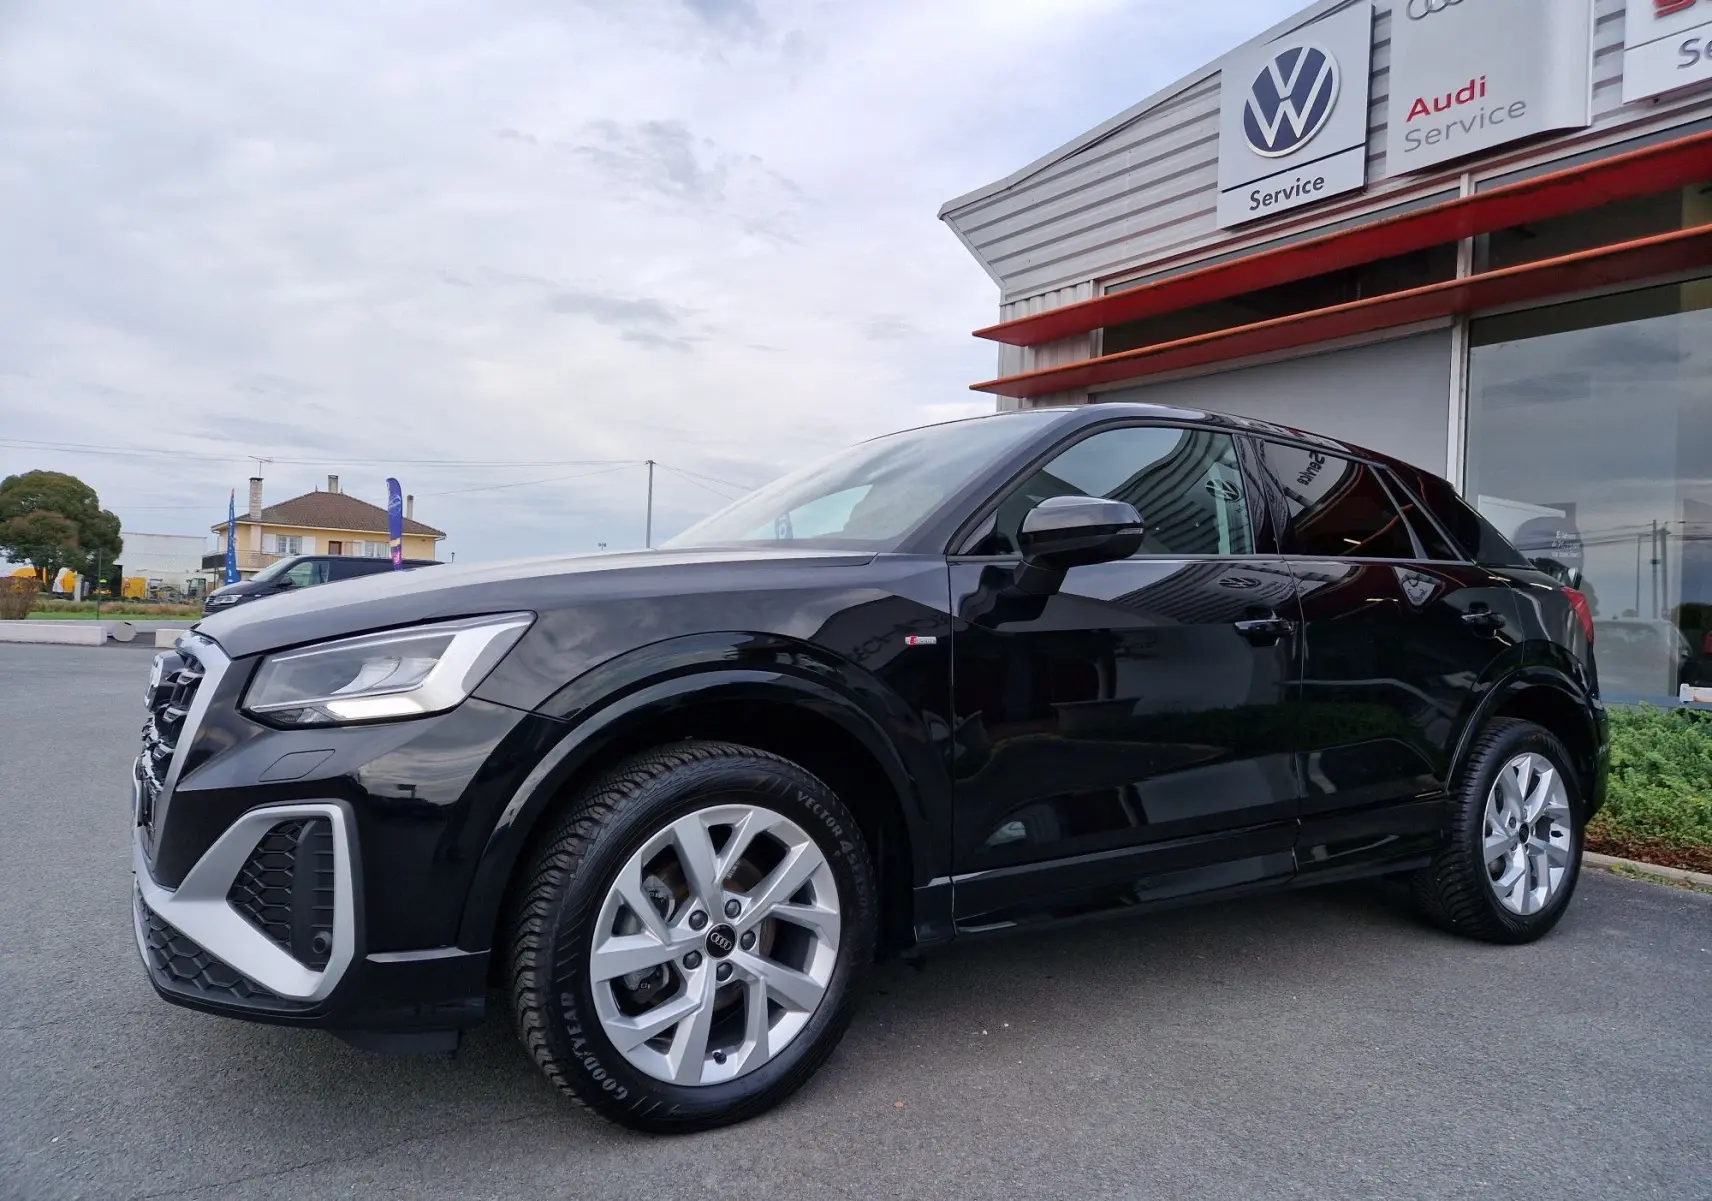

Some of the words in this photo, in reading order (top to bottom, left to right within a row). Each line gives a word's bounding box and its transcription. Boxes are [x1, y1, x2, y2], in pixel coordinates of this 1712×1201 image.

[1406, 75, 1487, 122] Audi
[1403, 100, 1527, 153] Service
[1249, 176, 1325, 211] Service
[797, 790, 843, 838] VECTOR
[560, 992, 629, 1100] GOODYEAR
